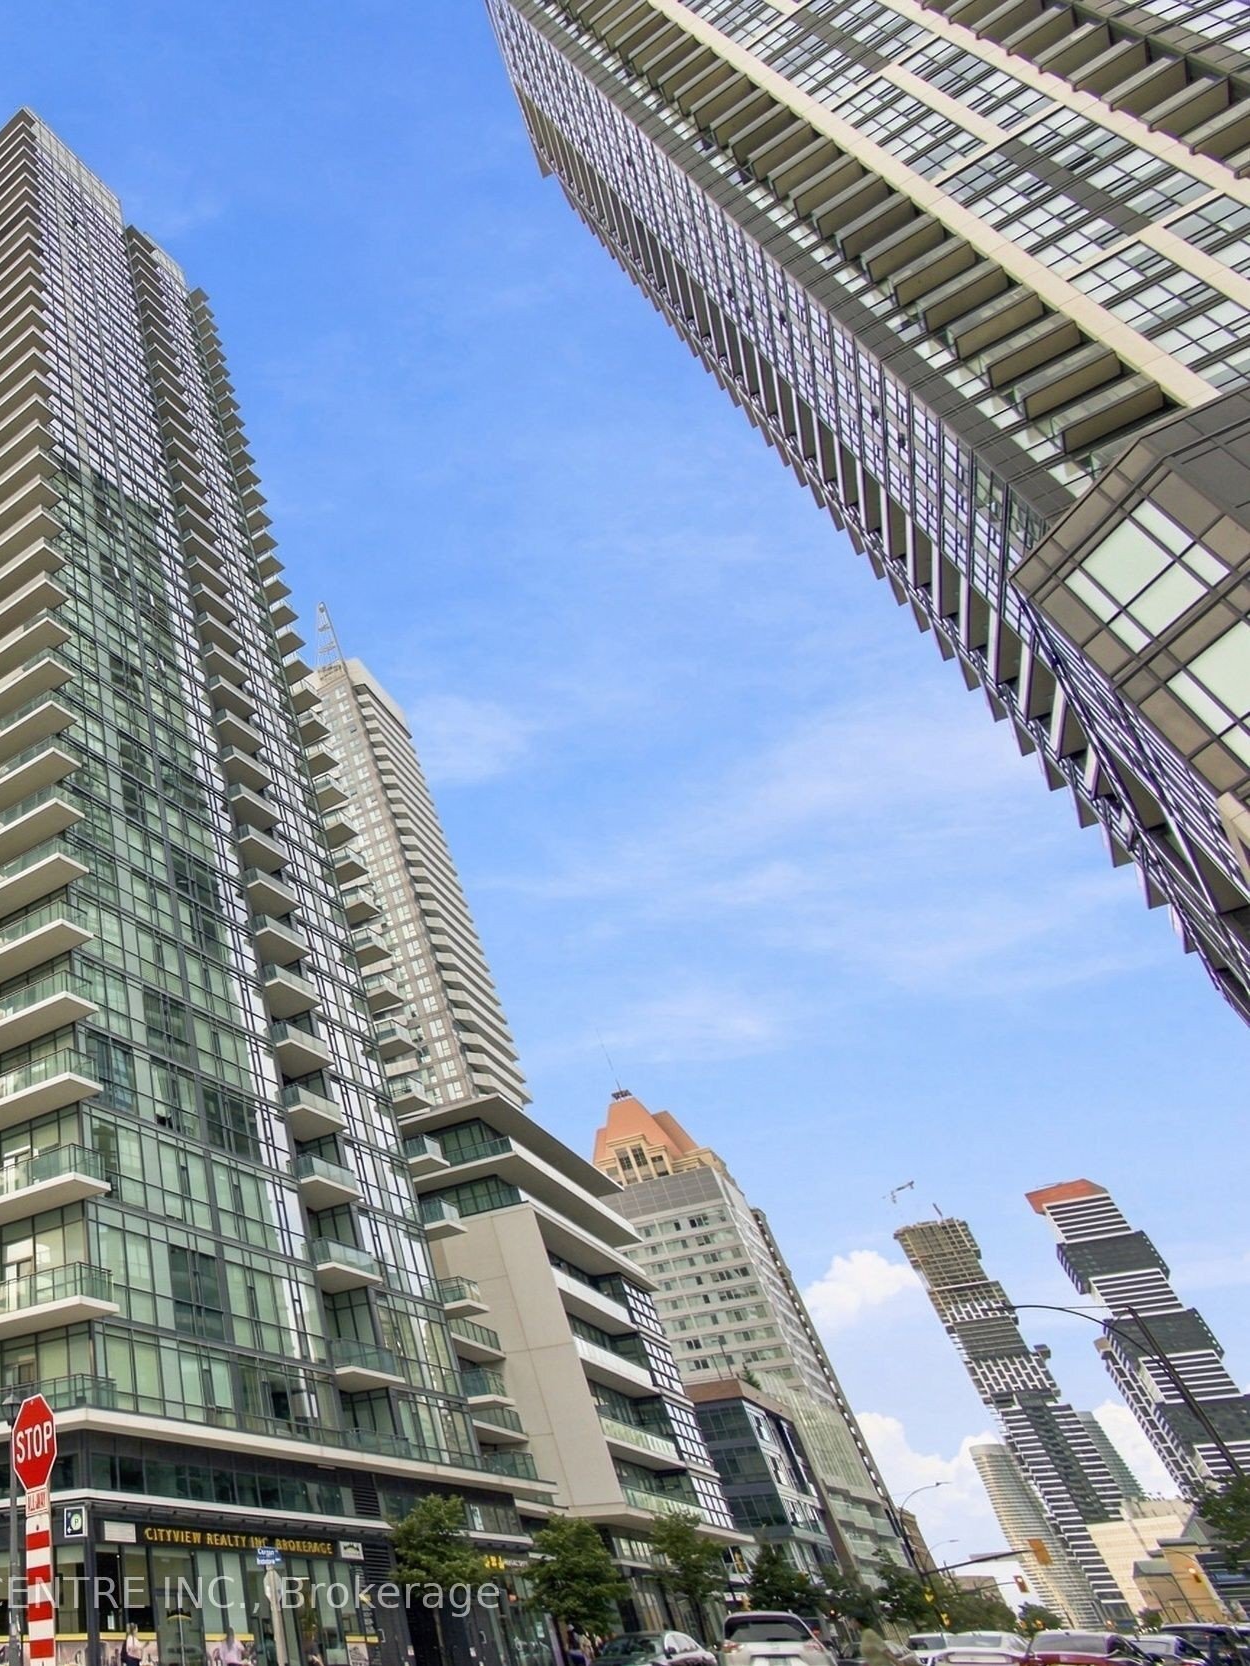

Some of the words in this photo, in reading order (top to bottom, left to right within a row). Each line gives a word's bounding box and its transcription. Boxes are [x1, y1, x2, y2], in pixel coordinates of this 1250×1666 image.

[16, 1421, 52, 1463] STOP
[144, 1527, 201, 1544] CITYVIEW
[206, 1533, 246, 1548] REALTY
[275, 1538, 333, 1555] BROKERAGE
